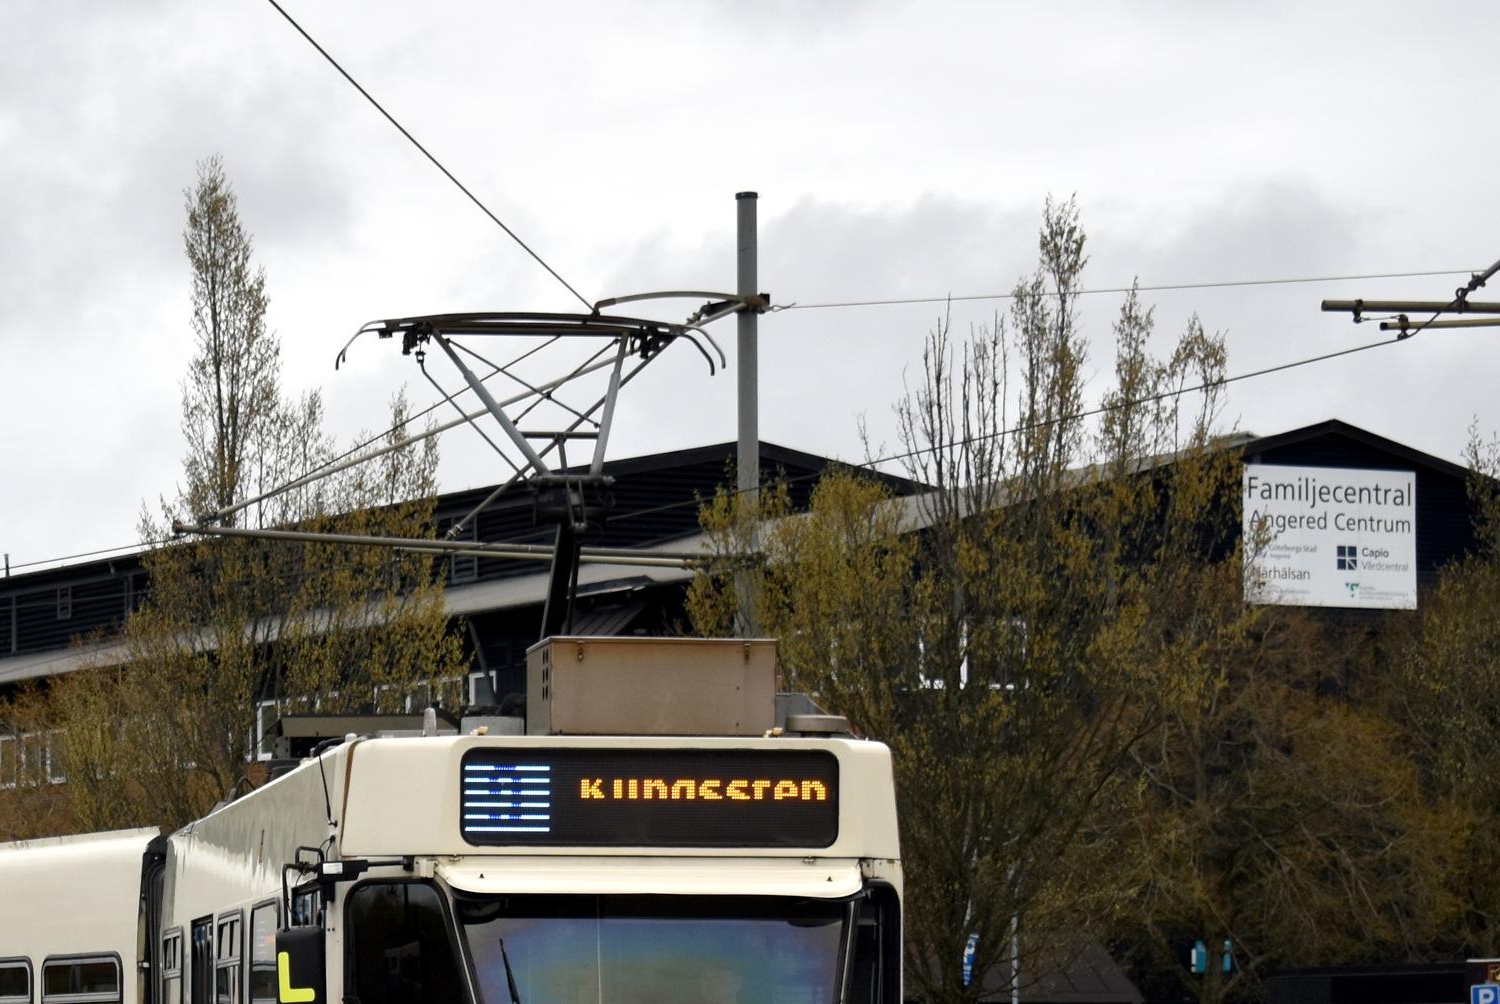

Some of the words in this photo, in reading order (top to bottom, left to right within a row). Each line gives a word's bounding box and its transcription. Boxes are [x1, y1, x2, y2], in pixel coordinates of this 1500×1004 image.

[1248, 476, 1411, 508] Familjecentral
[1250, 510, 1327, 533] Angered
[1335, 513, 1410, 534] Centrum
[1361, 547, 1389, 558] Capio
[1361, 560, 1409, 571] Vårdcentral
